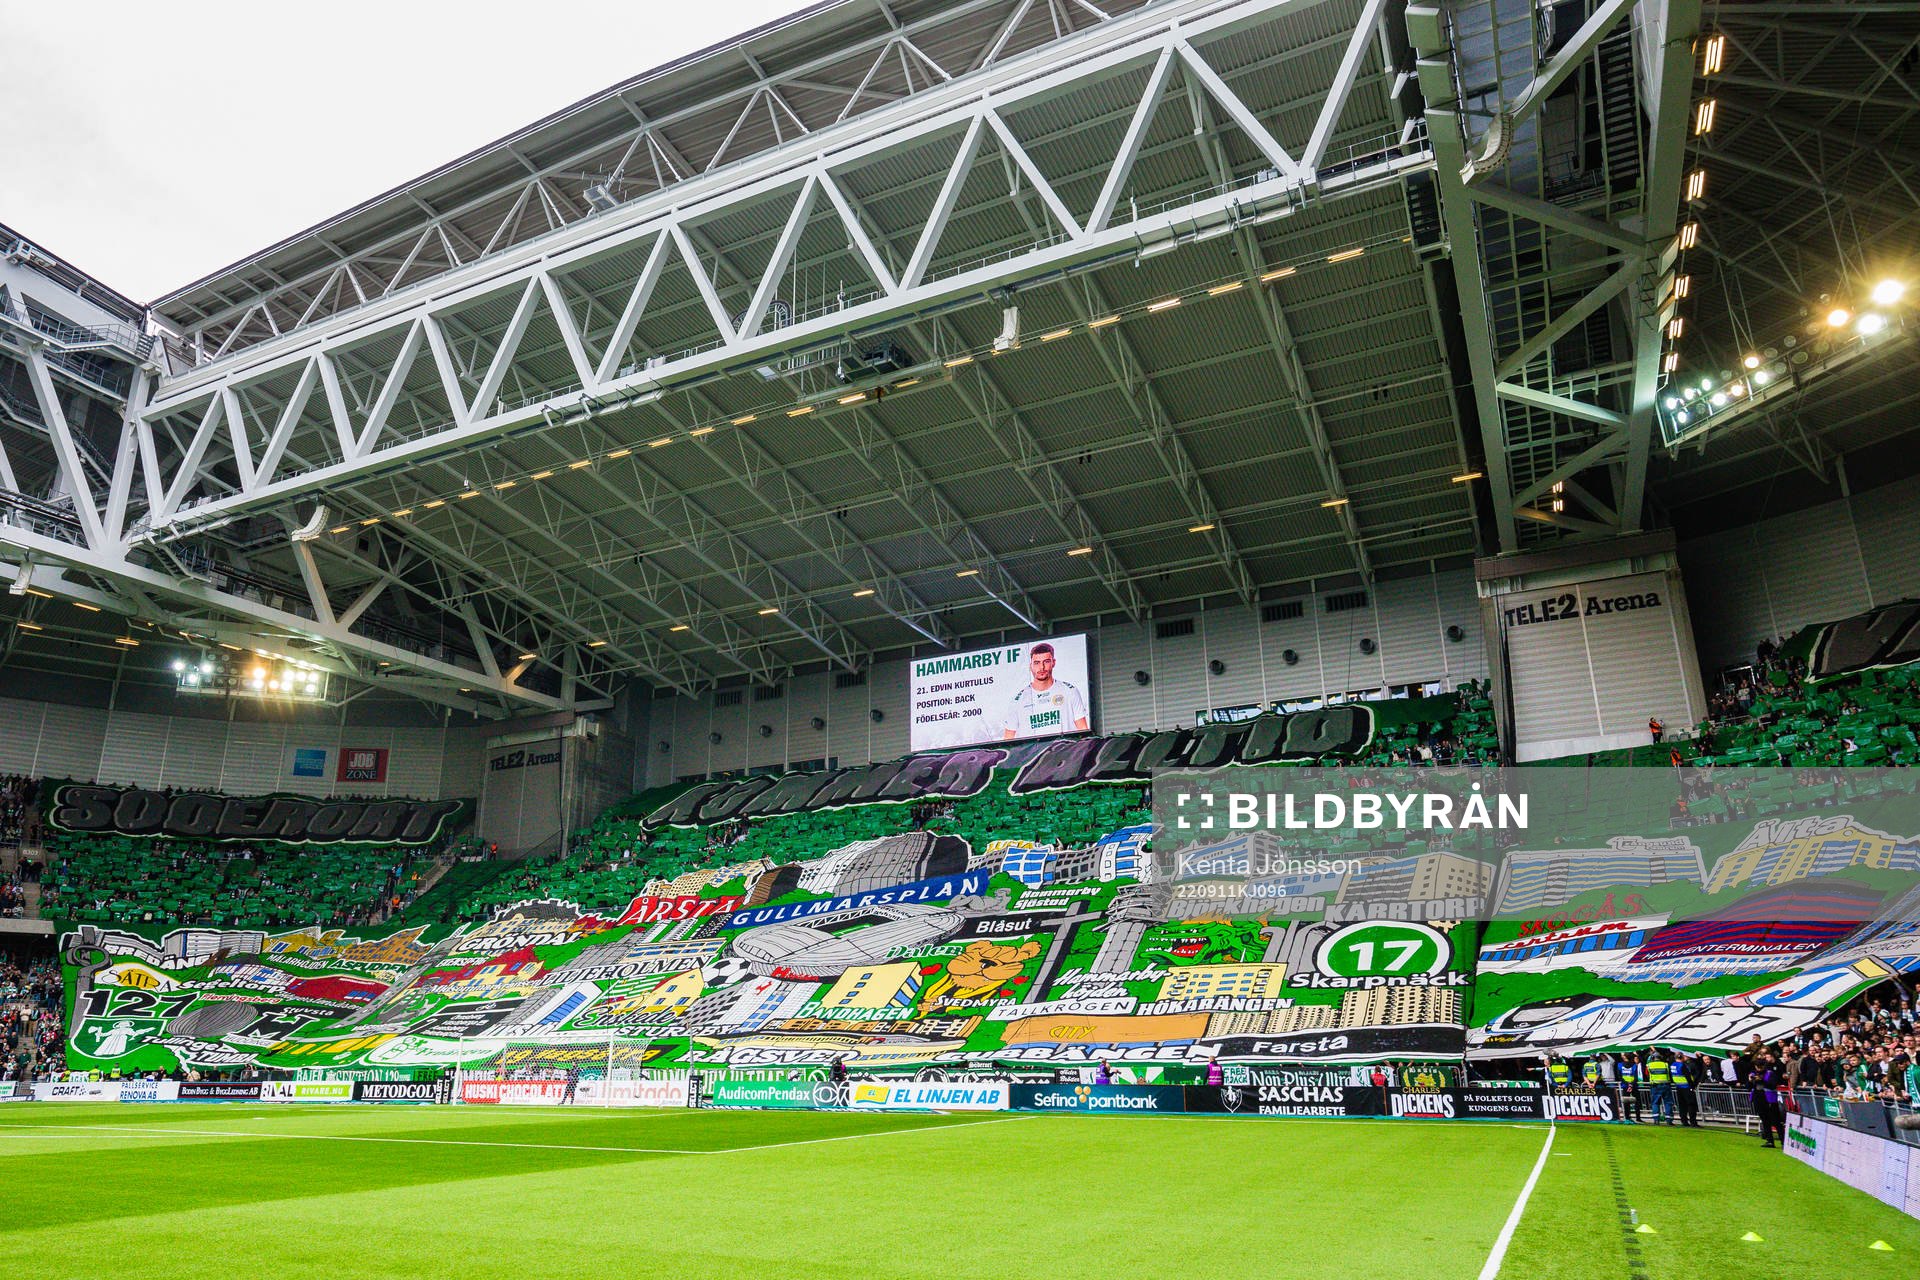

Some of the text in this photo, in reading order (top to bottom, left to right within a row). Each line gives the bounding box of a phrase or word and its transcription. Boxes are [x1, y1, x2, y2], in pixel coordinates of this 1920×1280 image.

[1505, 592, 1662, 627] TELE2 Arena
[916, 648, 1021, 677] HAMMARBY IF
[917, 676, 994, 695] 21. EDVIN KURTULUS
[916, 693, 976, 710] POSITION: BACK
[915, 708, 982, 724] FÖDELSEÅR: 2000
[1029, 710, 1061, 725] HUSKI
[1030, 719, 1061, 730] CHOCOLATE
[350, 752, 375, 769] JOB
[490, 750, 562, 772] TELE2 Arena
[346, 769, 377, 780] ZONE
[732, 877, 979, 925] GULLMARSPLAN
[1020, 887, 1101, 899] Hammarby
[617, 898, 735, 926] ÅRSTA
[1167, 895, 1326, 921] Björkhagen
[1324, 896, 1485, 921] KÄRRTORP
[1518, 893, 1642, 937] SKOGÅS
[975, 918, 1032, 933] Blåsut
[458, 932, 580, 952] GRÖNDAL
[102, 943, 213, 970] BREDÄNG
[1349, 940, 1423, 971] 17
[331, 960, 410, 973] ASPUDDEN
[538, 954, 713, 985] LILJEHOLMEN
[102, 969, 172, 992] SÄTRA
[180, 979, 286, 994] Segeltorp
[1290, 972, 1469, 989] Skarpnäck
[201, 994, 282, 1004] Flemingsberg
[1060, 981, 1128, 1001] höjden
[82, 989, 200, 1019] 127
[935, 995, 1017, 1008] SVEDMYRA
[998, 1001, 1131, 1017] TALLKROGEN
[1137, 995, 1293, 1016] HÖKARÄNGEN
[283, 1007, 335, 1016] Stuvsta
[574, 1005, 677, 1027] Enskede
[793, 1001, 915, 1020] BANDHAGEN
[613, 1024, 739, 1037] STUREBY
[1049, 1025, 1097, 1040] CITY
[142, 1036, 219, 1052] Tullinge
[1252, 1035, 1349, 1054] Farsta
[933, 1043, 1224, 1062] GUBBÄNGEN
[1223, 1067, 1246, 1075] FREE
[1251, 1070, 1281, 1086] Non
[1281, 1070, 1315, 1086] Plus
[52, 1086, 80, 1096] CRAFT
[120, 1091, 157, 1099] RENOVA AB
[210, 1087, 214, 1095] &
[250, 1087, 259, 1095] AB
[262, 1082, 293, 1097] RIVAL
[301, 1087, 343, 1095] RIVARE.NU
[465, 1084, 498, 1099] HUSKI
[601, 1081, 682, 1098] limitado
[689, 1080, 698, 1108] SELECT
[718, 1086, 810, 1101] AudicomPendax
[894, 1089, 1000, 1104] EL LINJEN AB
[1258, 1087, 1344, 1102] SASCHAS
[1402, 1086, 1441, 1094] CHARLES
[1554, 1087, 1597, 1095] CHARLES
[1034, 1092, 1157, 1110] Sefina pantbank
[1391, 1093, 1455, 1118] DICKENS
[1464, 1094, 1474, 1102] PÅ
[1259, 1106, 1345, 1116] FAMILJEARBETE
[1542, 1095, 1613, 1120] DICKENS
